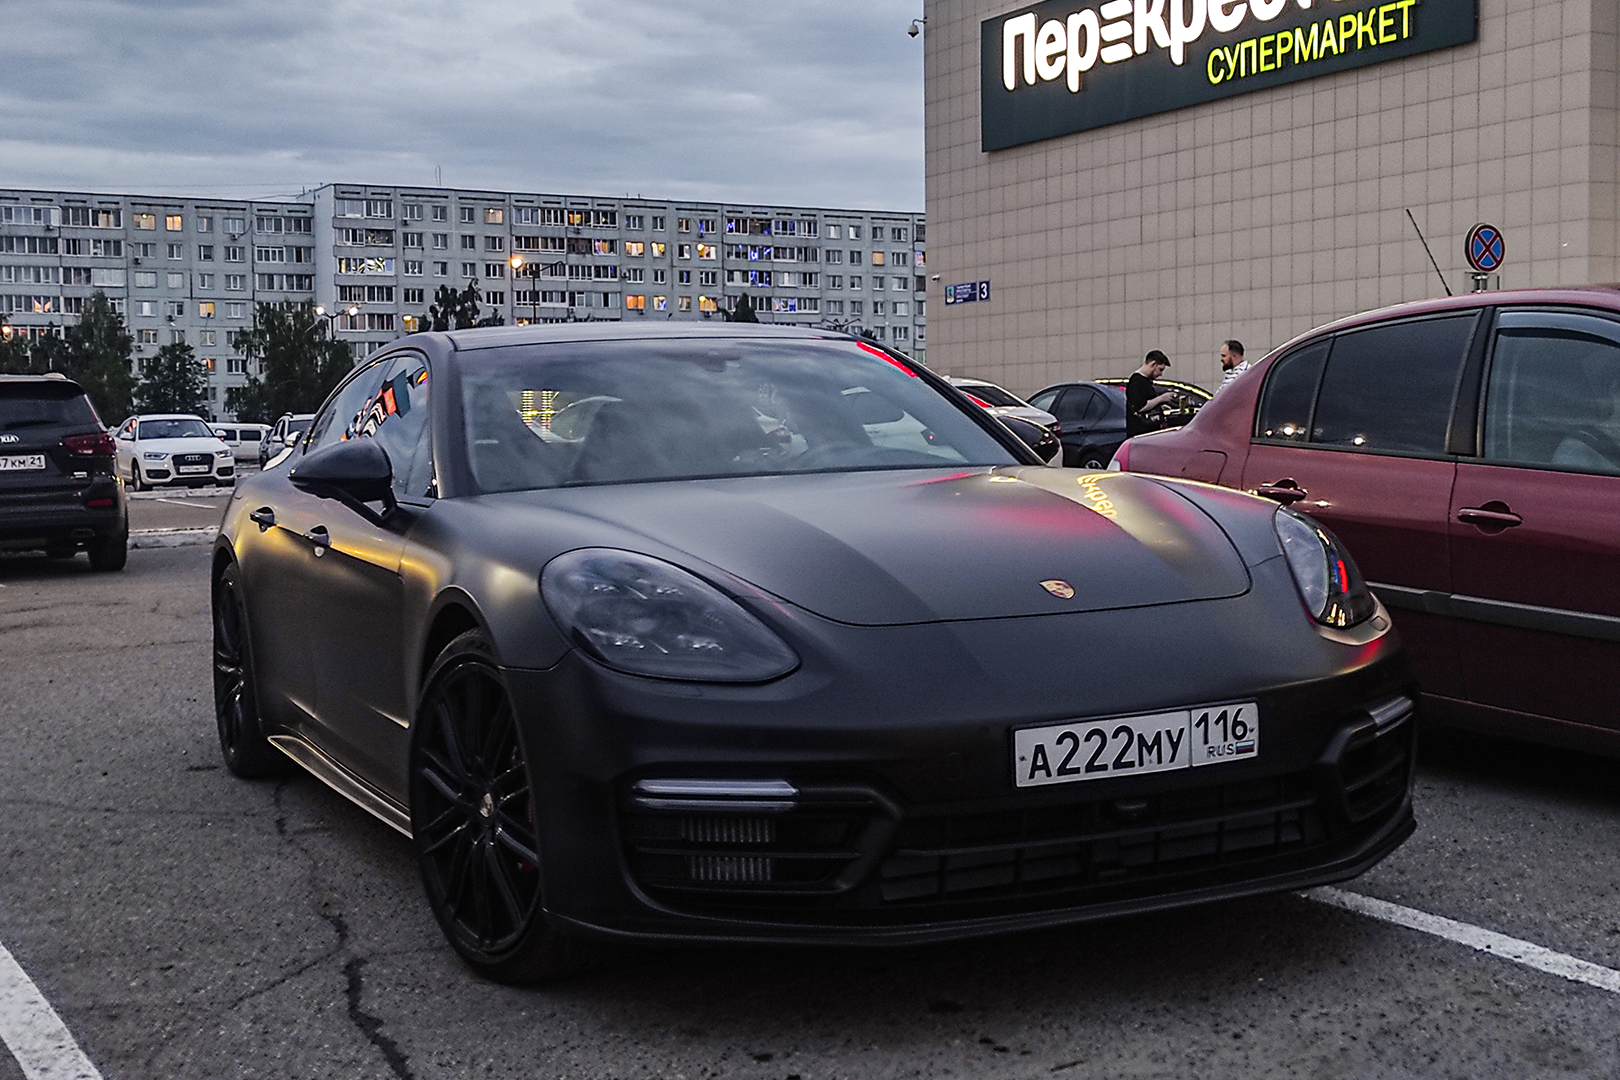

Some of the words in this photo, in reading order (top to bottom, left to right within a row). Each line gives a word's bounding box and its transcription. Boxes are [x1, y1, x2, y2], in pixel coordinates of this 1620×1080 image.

[1003, 0, 1313, 93] Перекр
[1207, 0, 1416, 85] СУПЕРМАРКЕТ
[980, 283, 988, 299] 3
[0, 457, 26, 468] 7КМ
[30, 456, 42, 464] 21
[1028, 724, 1185, 780] А222МУ
[1194, 708, 1248, 745] 116
[1206, 744, 1235, 759] RUS
